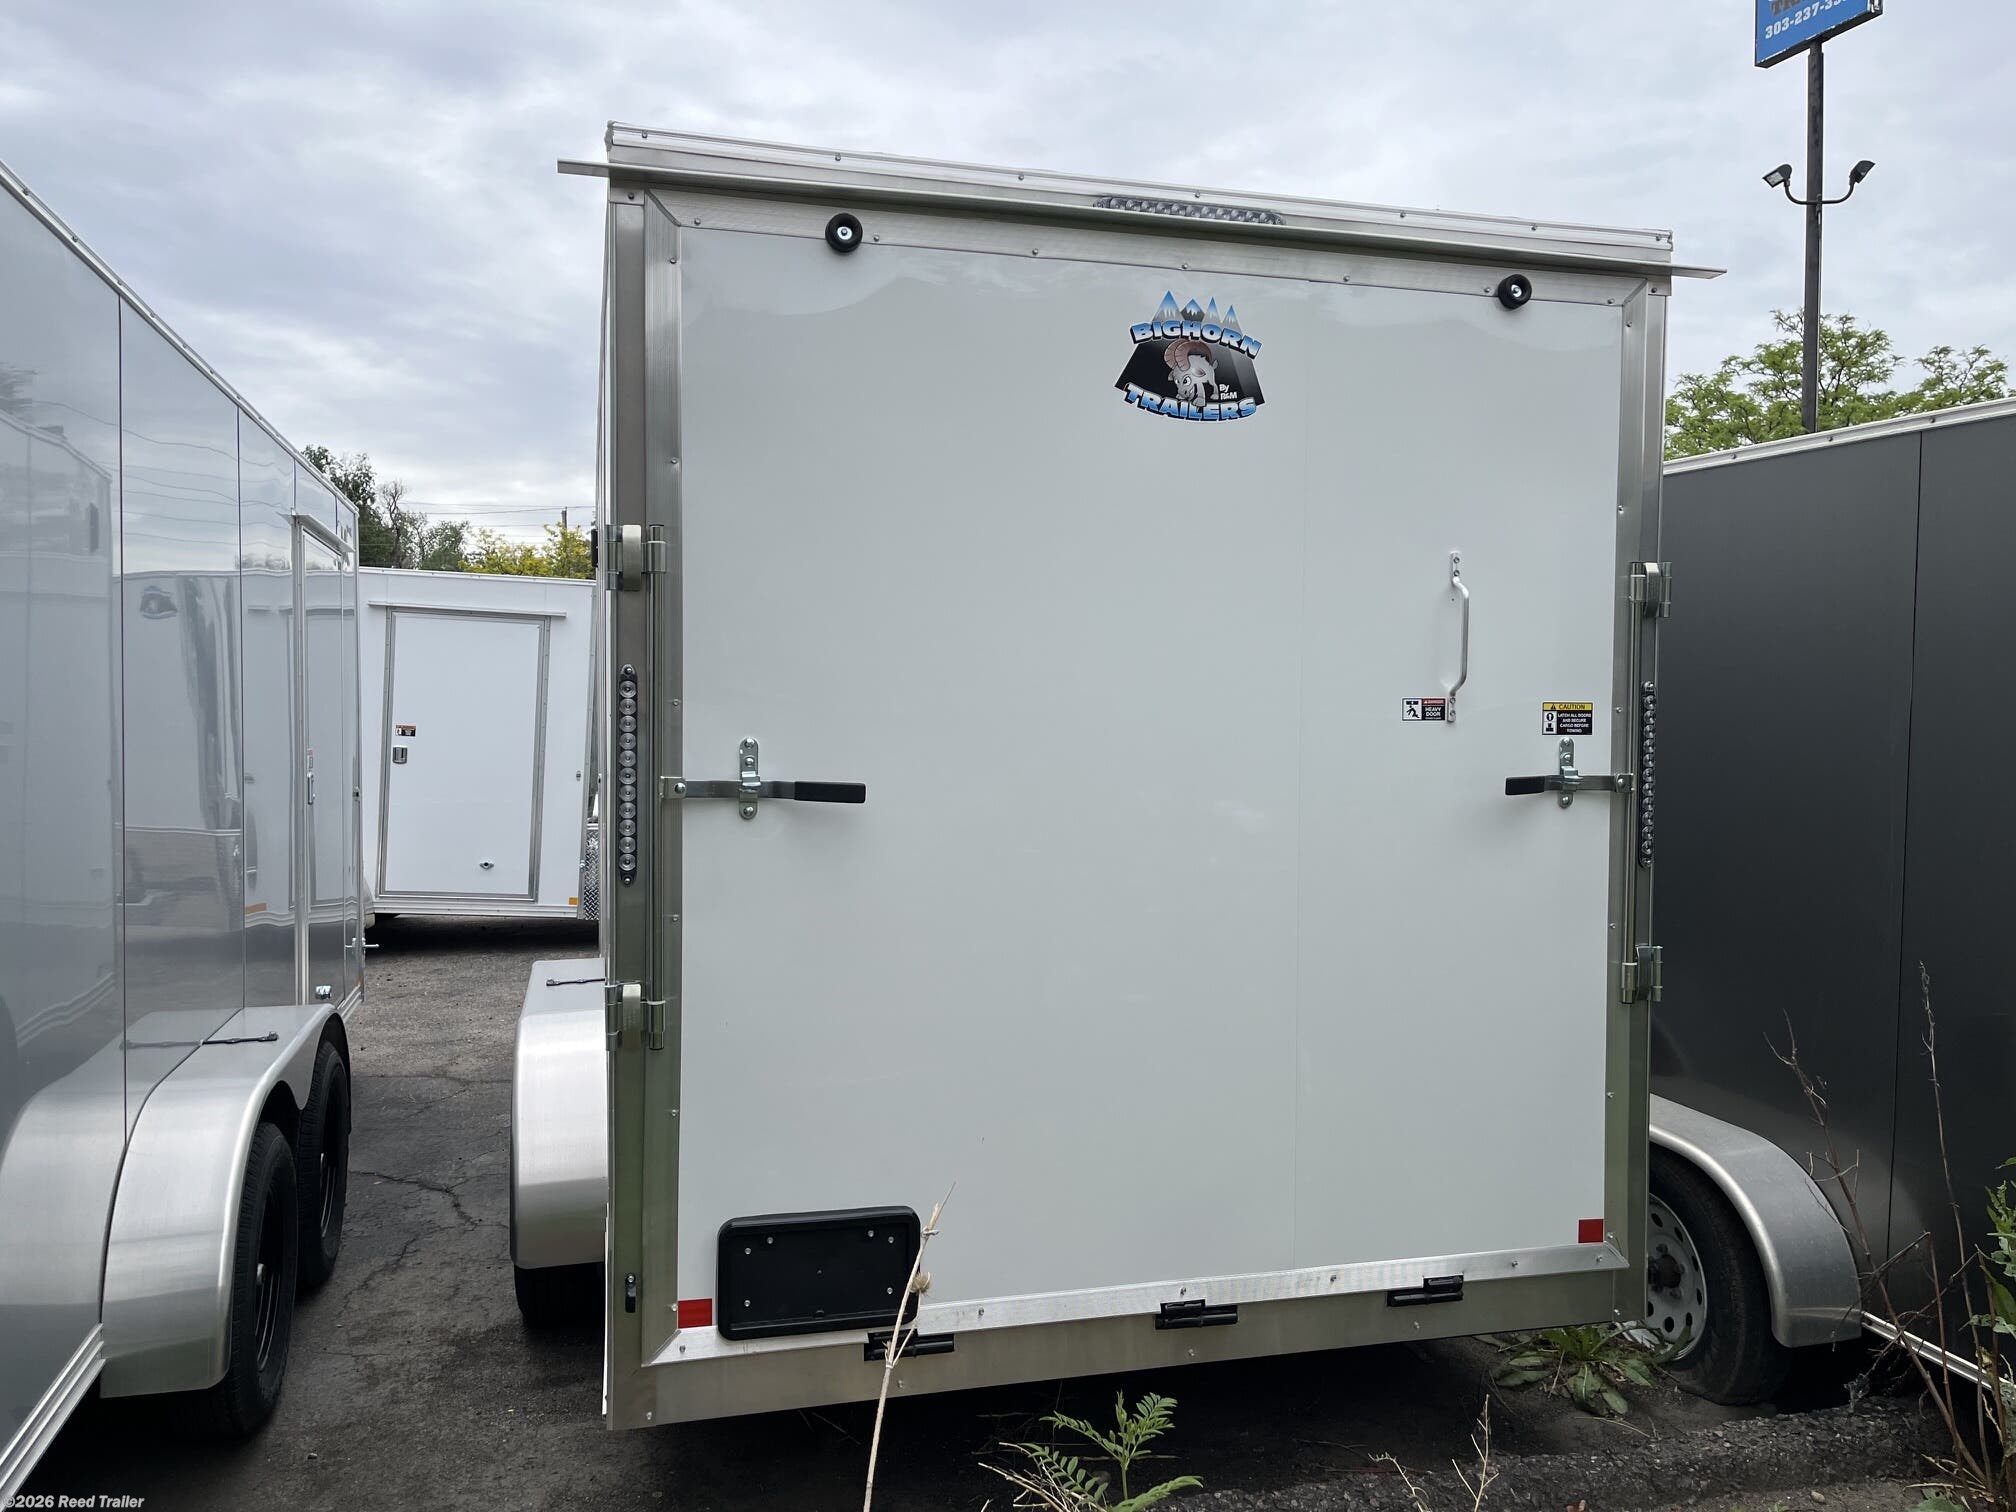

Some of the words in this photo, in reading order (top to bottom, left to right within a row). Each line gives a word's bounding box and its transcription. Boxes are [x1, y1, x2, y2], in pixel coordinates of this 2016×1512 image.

[1130, 320, 1262, 359] BIGHORN
[1125, 383, 1257, 421] TRAILERS
[1219, 384, 1230, 392] By
